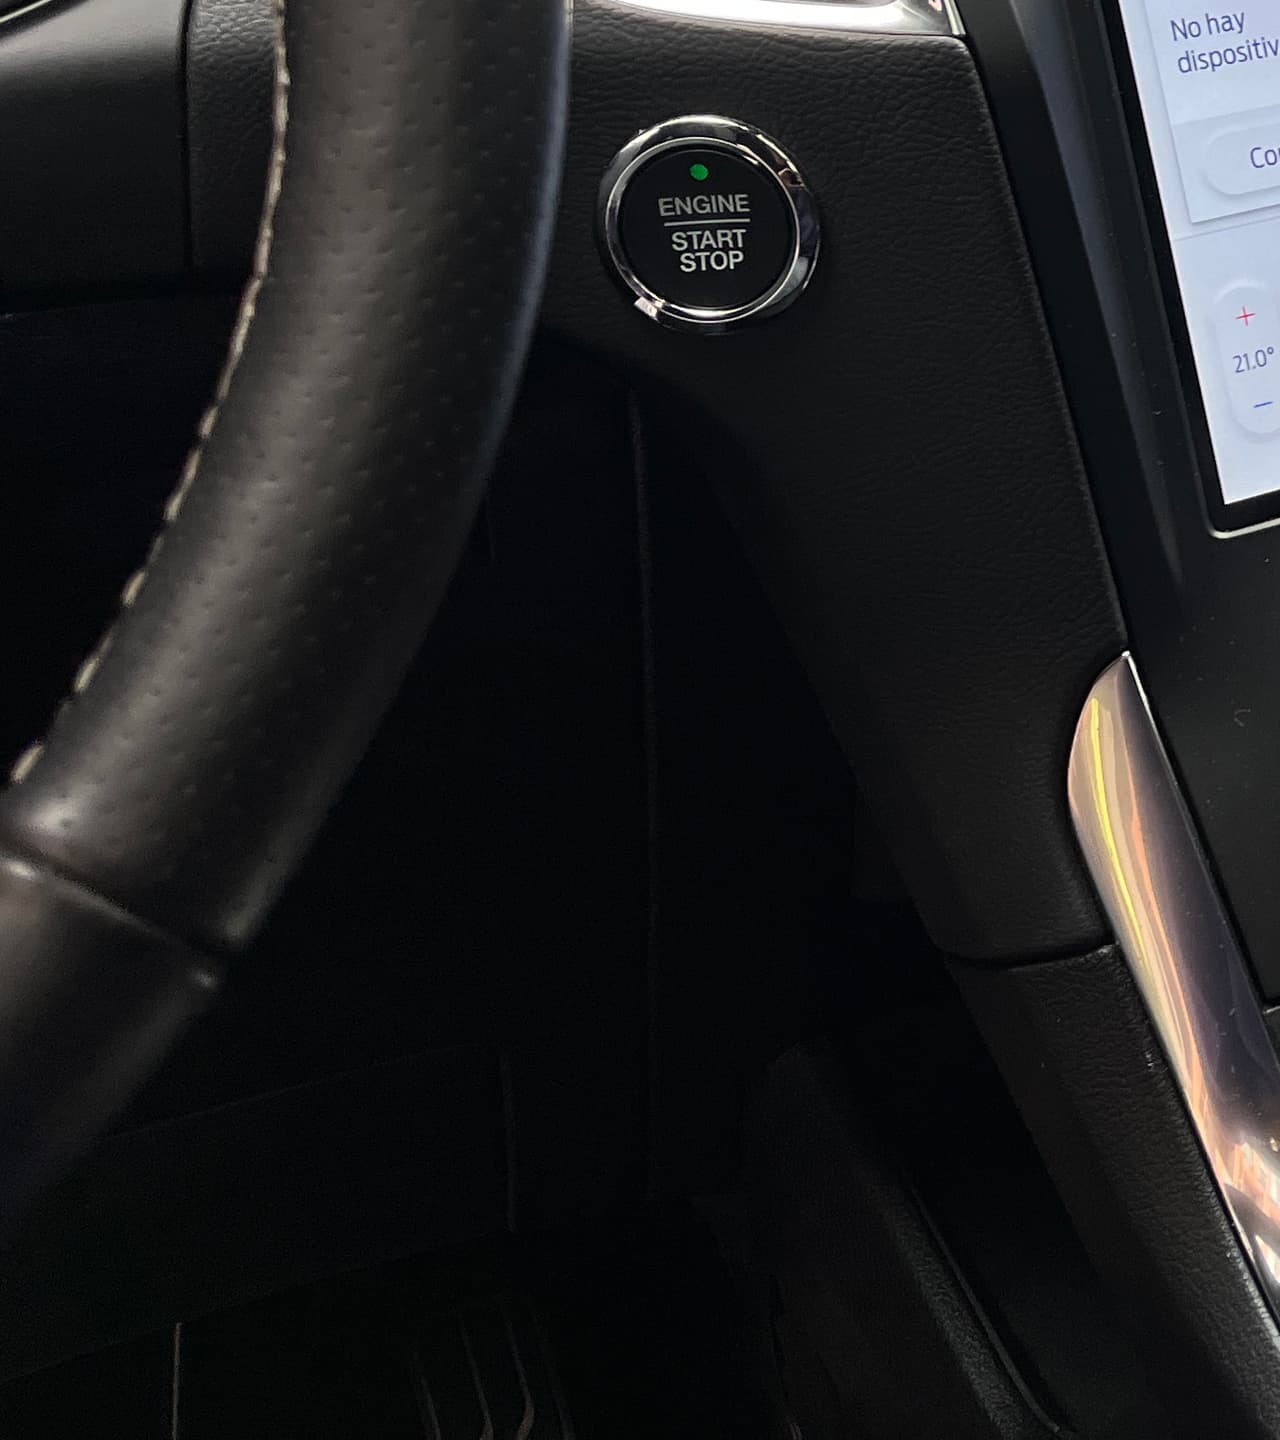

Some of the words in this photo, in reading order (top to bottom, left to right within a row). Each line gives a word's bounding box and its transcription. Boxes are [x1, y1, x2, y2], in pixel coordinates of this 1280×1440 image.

[1170, 18, 1202, 42] No
[1204, 12, 1245, 35] hay
[658, 193, 751, 217] ENGINE
[671, 228, 747, 251] START
[679, 250, 744, 273] STOP
[1232, 346, 1275, 374] 21.0°
